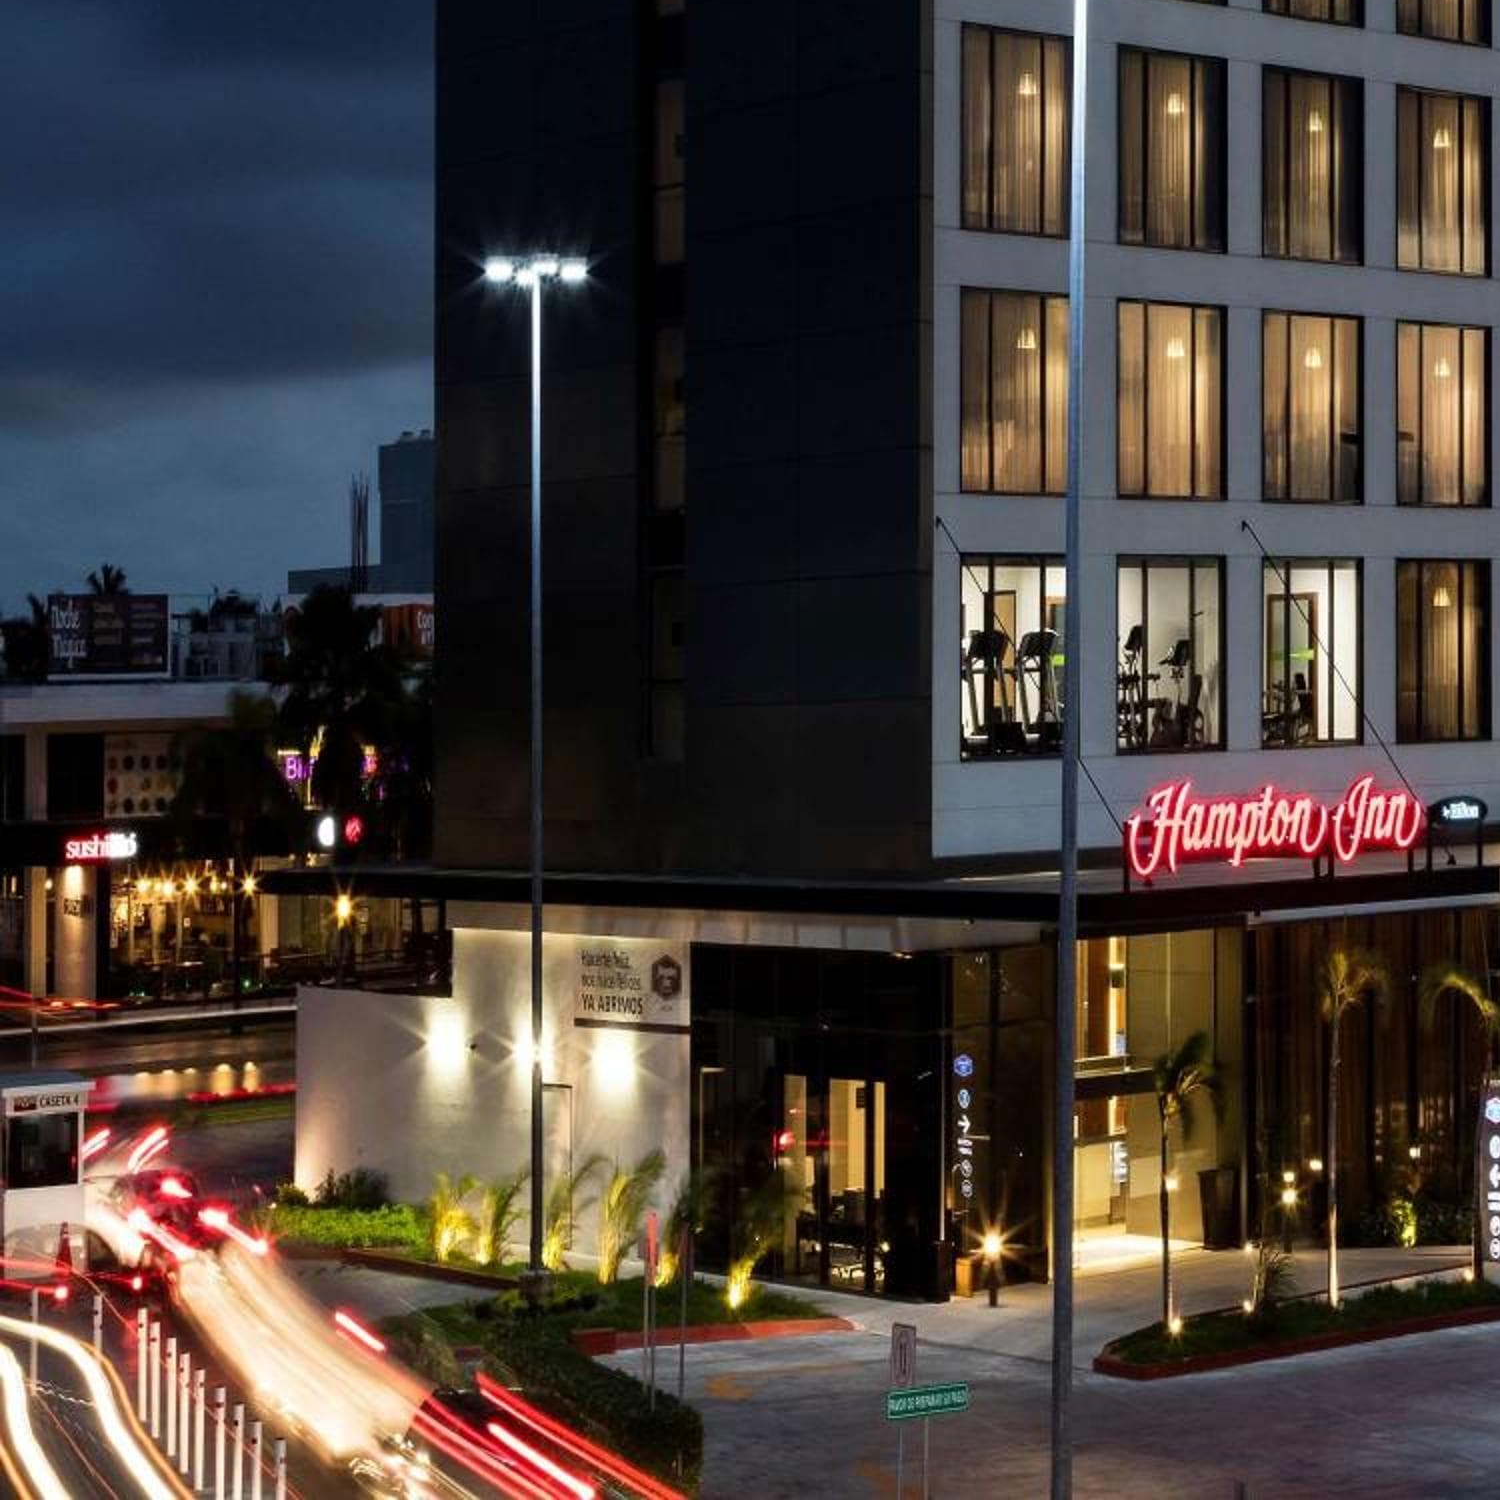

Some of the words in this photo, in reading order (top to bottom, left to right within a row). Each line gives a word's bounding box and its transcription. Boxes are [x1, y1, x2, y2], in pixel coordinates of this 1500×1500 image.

[1128, 780, 1328, 876] Hampton
[1334, 773, 1422, 861] Inn
[581, 994, 595, 1011] YA
[40, 1094, 71, 1108] CASETA
